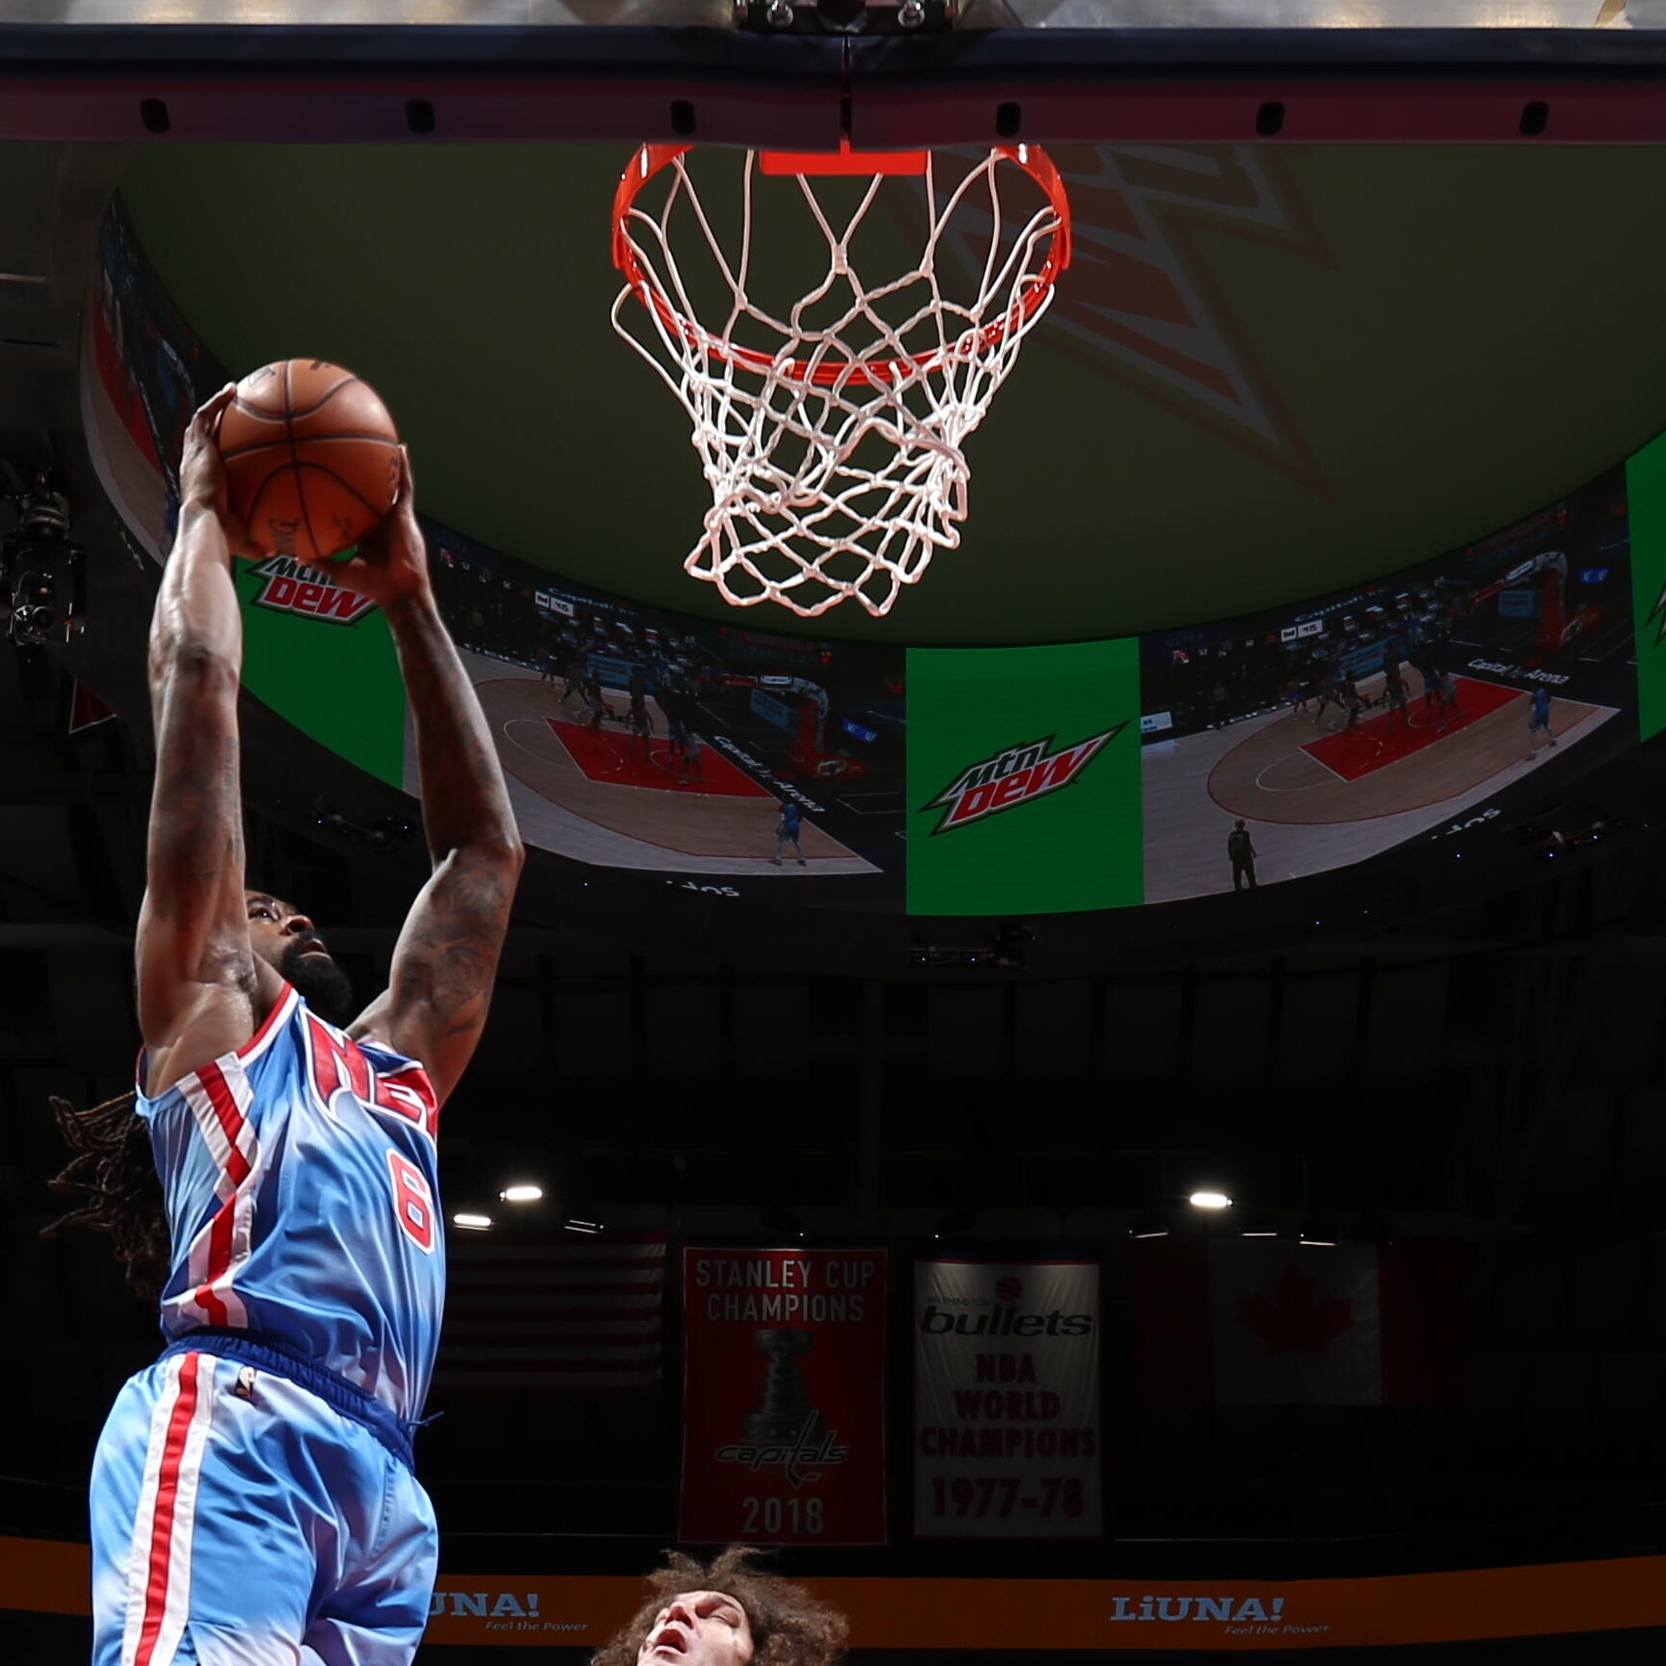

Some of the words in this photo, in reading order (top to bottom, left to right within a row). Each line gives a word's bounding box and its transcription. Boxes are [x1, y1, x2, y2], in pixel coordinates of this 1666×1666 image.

[388, 1149, 435, 1254] 6
[695, 1259, 812, 1288] STANLEY
[825, 1260, 876, 1289] CUP
[707, 1293, 864, 1322] CHAMPIONS
[922, 1304, 1094, 1336] bullets
[976, 1353, 1037, 1383] NBA
[954, 1390, 1061, 1420] WORLD
[919, 1426, 1096, 1458] CHAMPIONS
[932, 1477, 1083, 1517] 1977-78
[741, 1497, 824, 1535] 2018
[1110, 1595, 1285, 1621] LiUNA!
